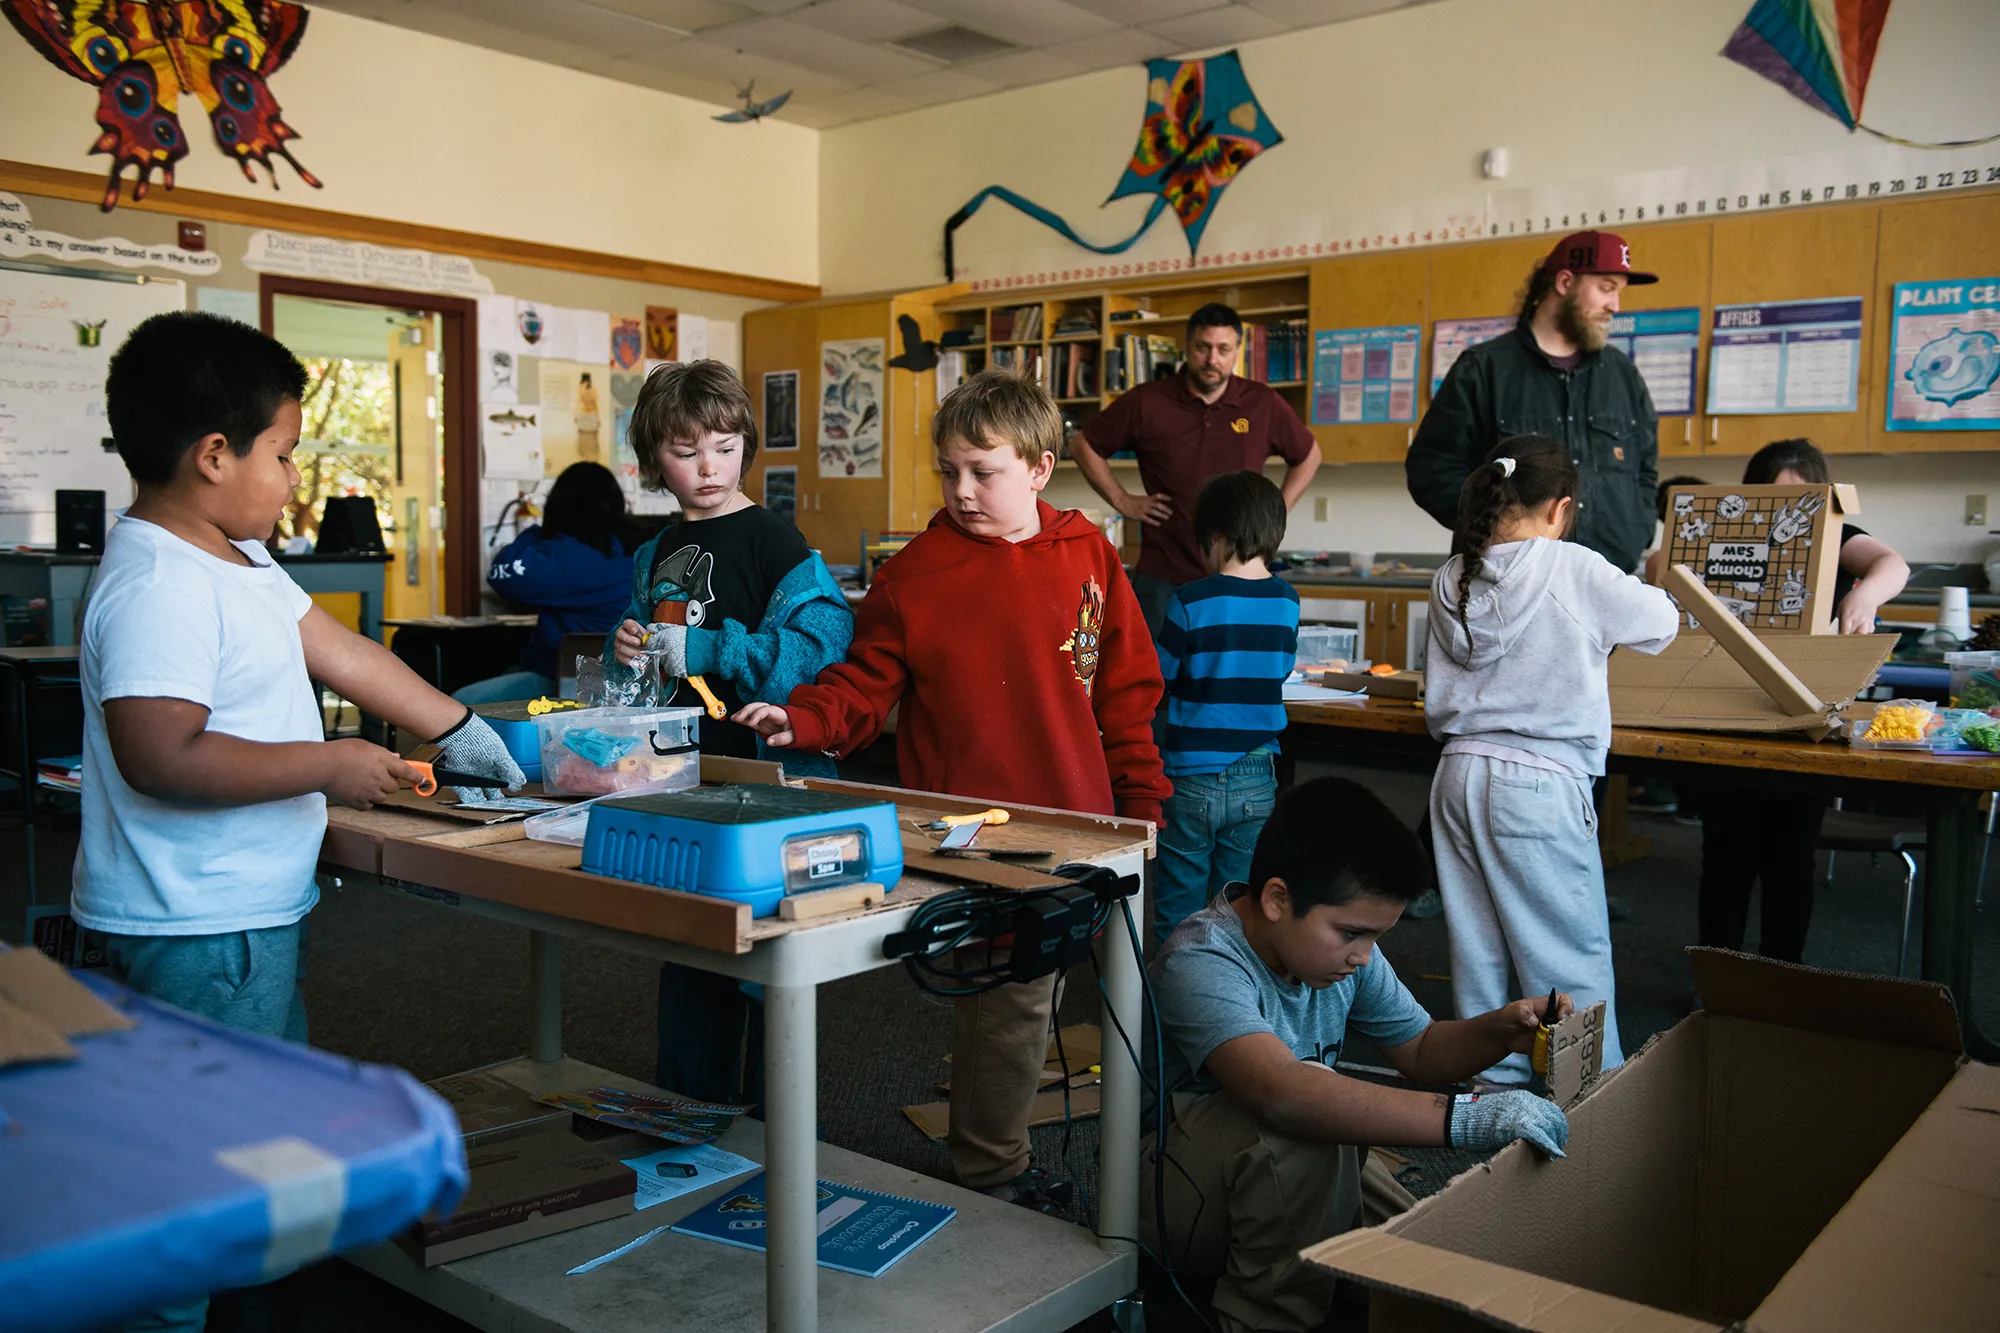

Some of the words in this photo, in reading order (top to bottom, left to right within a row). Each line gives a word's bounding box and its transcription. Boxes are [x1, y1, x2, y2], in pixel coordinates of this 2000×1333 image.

[1657, 204, 1664, 216] 9
[1675, 201, 1688, 215] 10
[1697, 200, 1706, 213] 11
[1717, 197, 1727, 211] 12
[1738, 195, 1748, 209] 13
[1759, 193, 1770, 206] 14
[1780, 190, 1790, 204] 15
[1801, 188, 1812, 202] 16
[1823, 186, 1834, 199] 17
[1845, 184, 1858, 198] 18
[1868, 182, 1880, 196] 19
[1890, 180, 1905, 192] 20
[1915, 175, 1928, 190] 21
[1937, 172, 1954, 187] 22
[1962, 169, 1979, 185] 23
[28, 235, 42, 247] Is
[46, 240, 64, 252] my
[68, 243, 109, 254] answer
[113, 245, 146, 259] based
[150, 252, 164, 260] on
[167, 252, 185, 263] the
[188, 255, 217, 266] text?
[267, 233, 356, 260] Discussion
[1899, 287, 1963, 307] PLANT
[1719, 309, 1761, 328] AFFIXES
[1722, 546, 1755, 558] Saw
[1708, 562, 1764, 579] Chomp
[811, 848, 840, 860] Chomp
[817, 863, 836, 874] Saw
